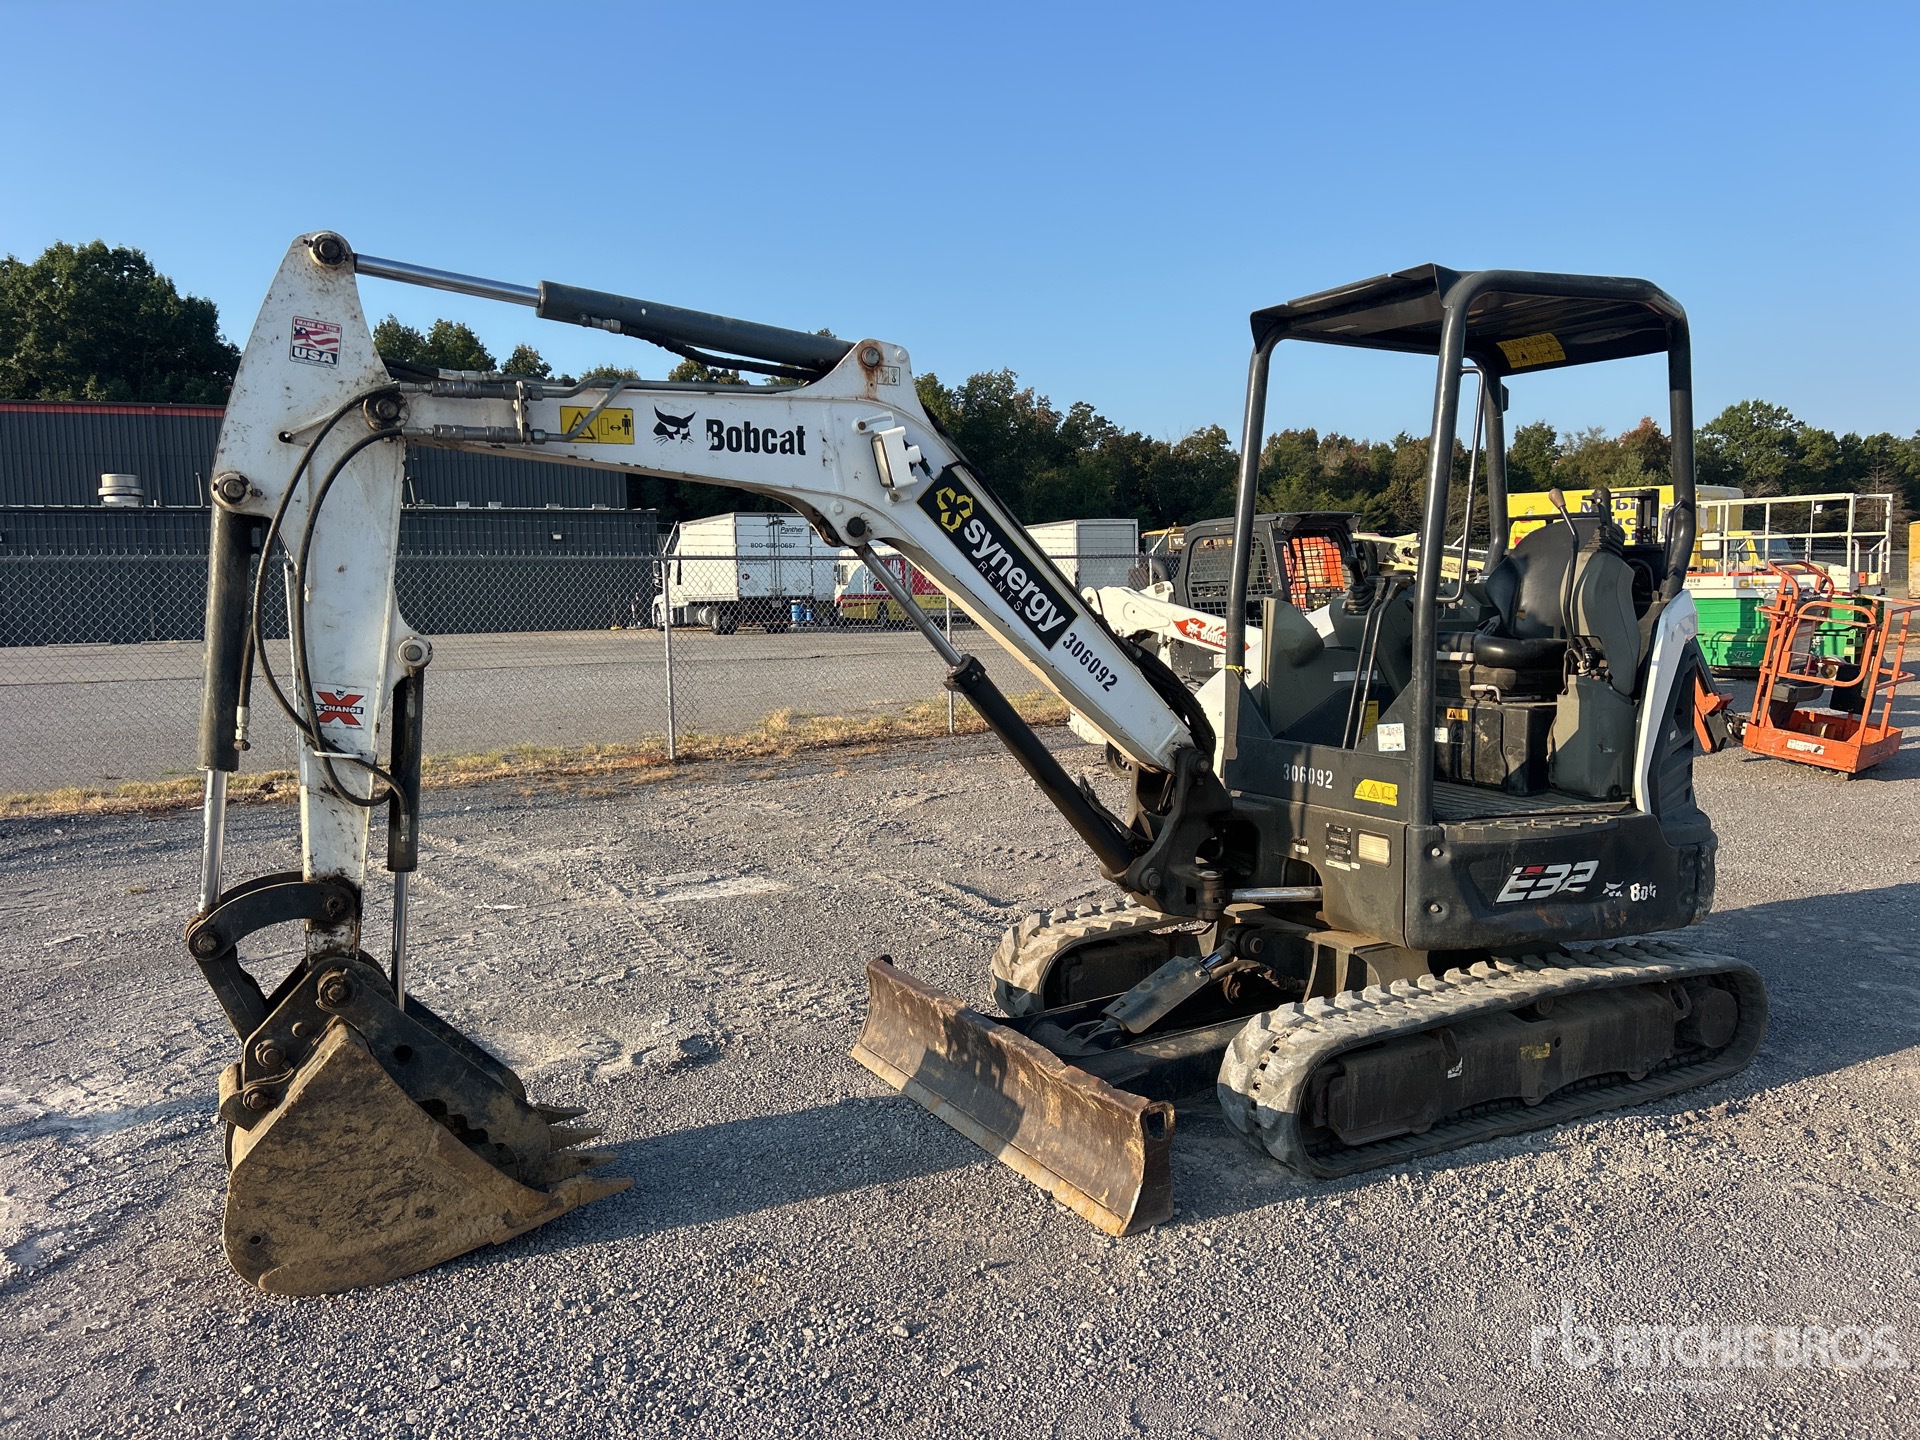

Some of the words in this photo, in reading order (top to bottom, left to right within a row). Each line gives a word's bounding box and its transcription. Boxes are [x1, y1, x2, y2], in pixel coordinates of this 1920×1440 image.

[296, 320, 316, 328] MADE
[294, 347, 334, 364] USA
[706, 419, 807, 456] Bobcat
[963, 518, 1067, 632] synergy
[977, 560, 1023, 612] RENTS
[1200, 628, 1227, 646] Bobca
[1062, 632, 1118, 692] 306092
[1283, 763, 1333, 789] 306092
[1496, 860, 1600, 903] E32
